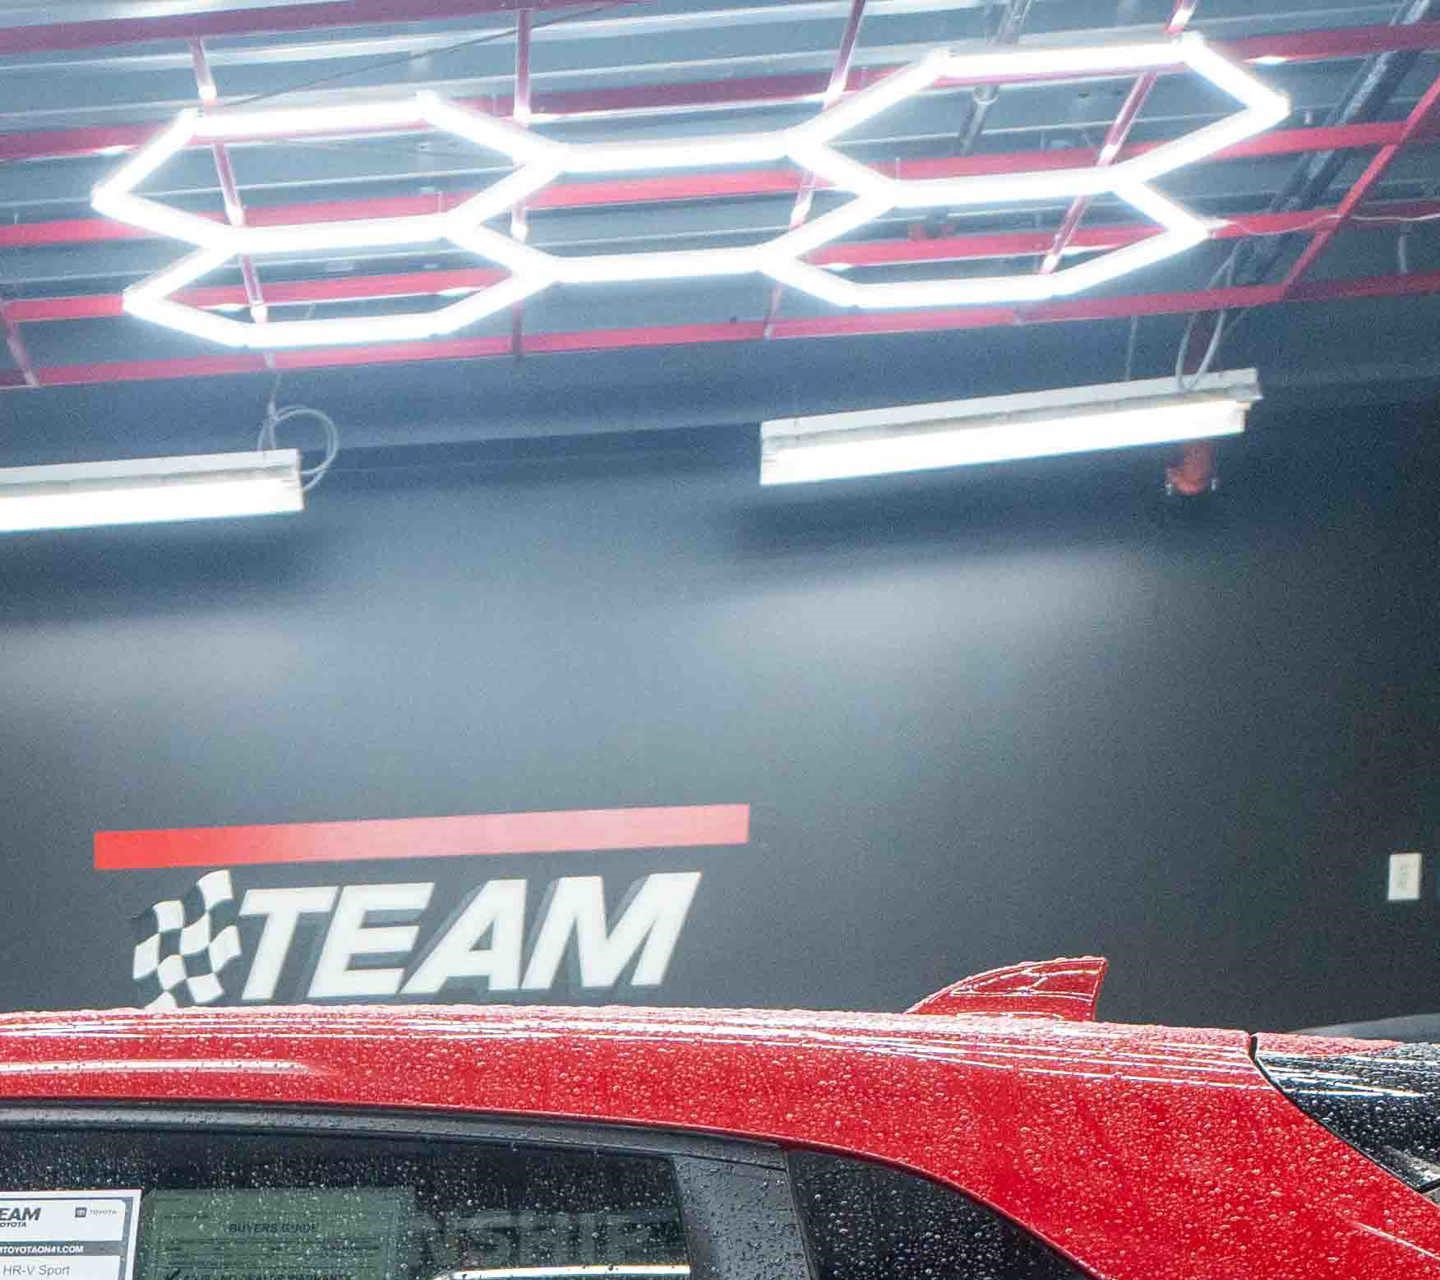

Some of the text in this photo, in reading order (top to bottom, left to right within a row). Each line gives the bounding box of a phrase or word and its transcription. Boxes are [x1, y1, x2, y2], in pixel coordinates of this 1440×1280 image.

[239, 871, 702, 1001] TEAM
[228, 1223, 279, 1233] BUYERS
[3, 1265, 36, 1276] HR-V
[38, 1264, 71, 1280] Sport
